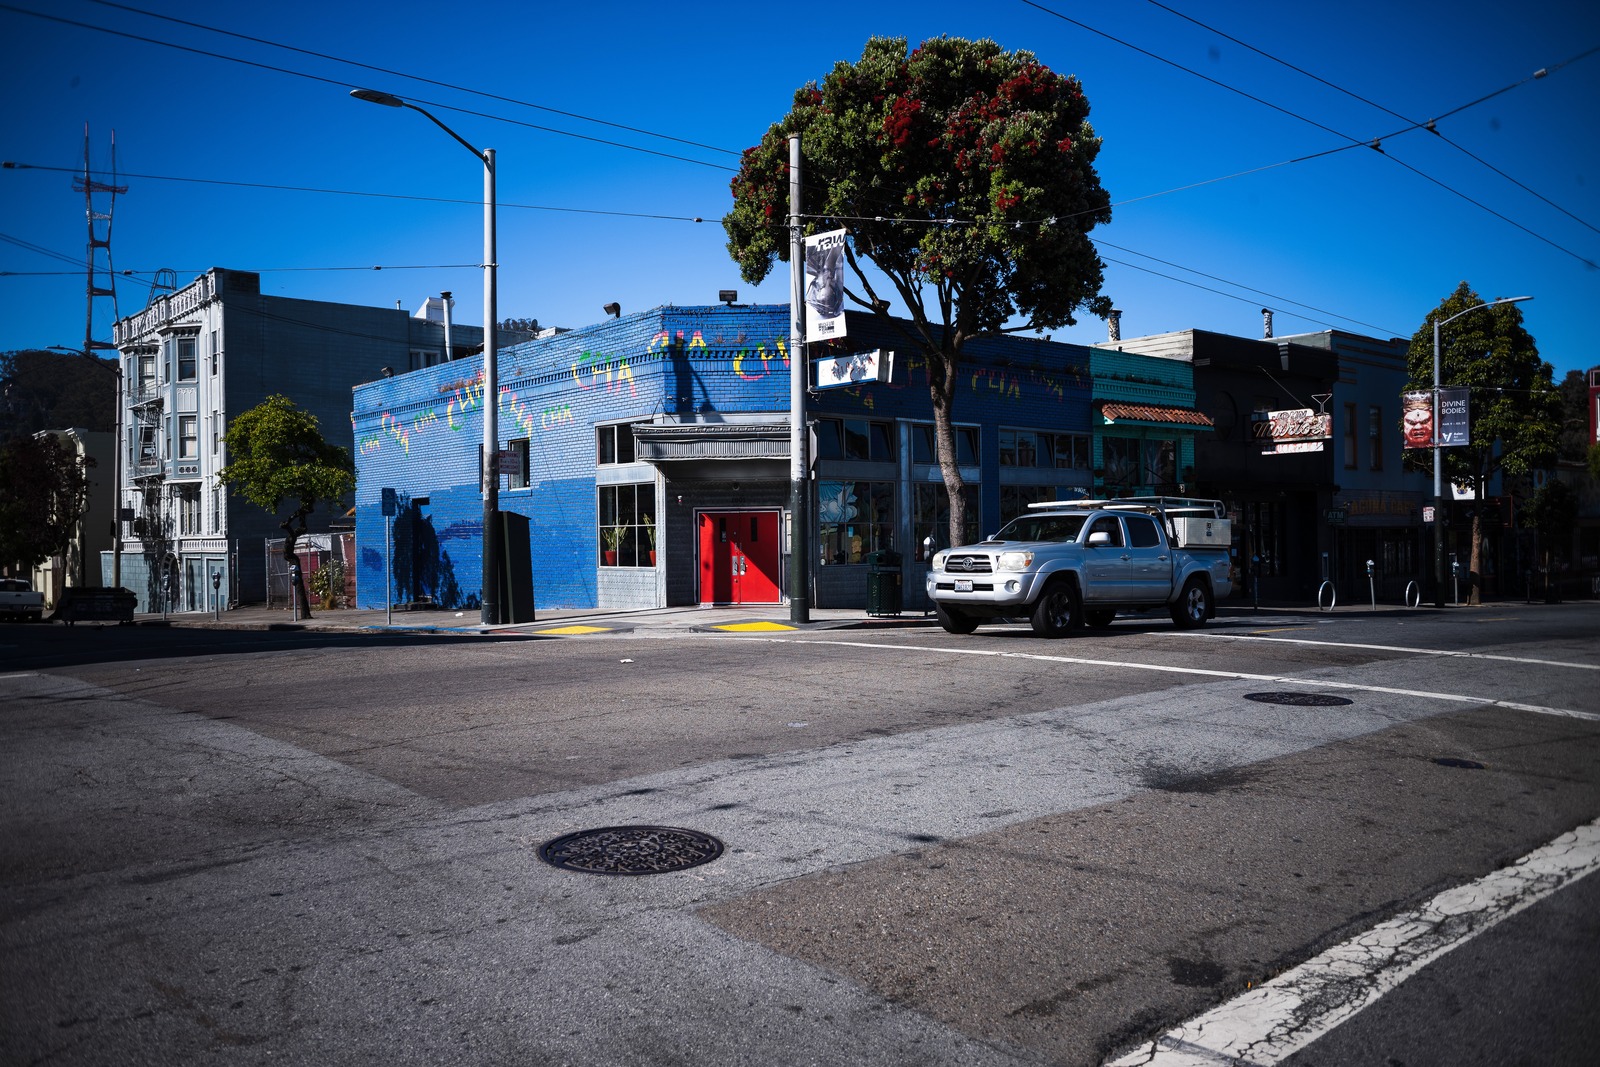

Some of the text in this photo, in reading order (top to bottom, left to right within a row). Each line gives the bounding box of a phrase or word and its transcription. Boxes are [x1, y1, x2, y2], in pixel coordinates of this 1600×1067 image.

[733, 336, 790, 380] CH
[360, 434, 381, 455] CHA
[542, 405, 574, 430] CHA
[572, 351, 636, 398] CHA
[1328, 511, 1344, 519] ATM
